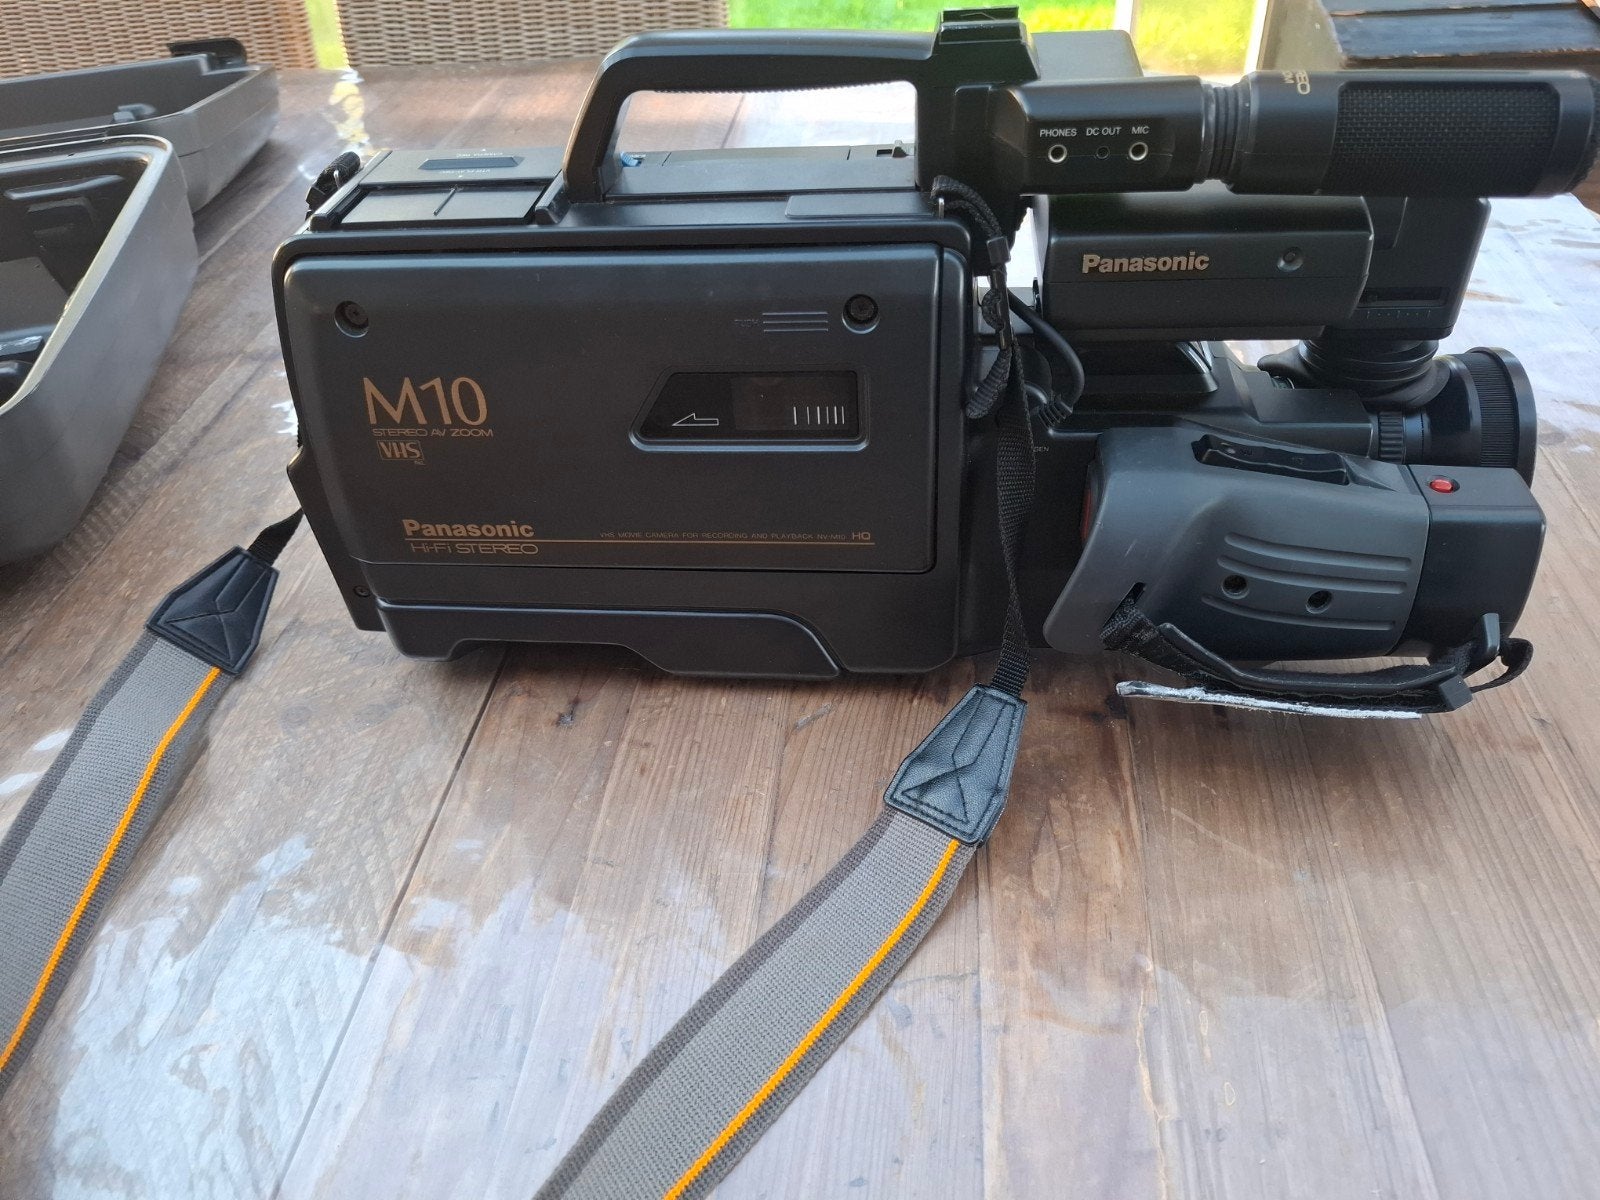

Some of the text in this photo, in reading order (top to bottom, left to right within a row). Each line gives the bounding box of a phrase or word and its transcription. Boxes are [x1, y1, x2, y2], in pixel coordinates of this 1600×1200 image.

[1039, 128, 1077, 137] PHONES
[1086, 126, 1121, 136] DC OUT
[1131, 125, 1150, 135] MIC
[1082, 251, 1210, 274] Panasonic
[362, 376, 488, 426] M10
[372, 428, 493, 437] STEREO AV ZOOM
[379, 441, 421, 459] VHS
[402, 519, 535, 538] Panasonic
[701, 532, 748, 540] RECORDING
[852, 531, 871, 541] HQ
[456, 543, 539, 555] STEREO
